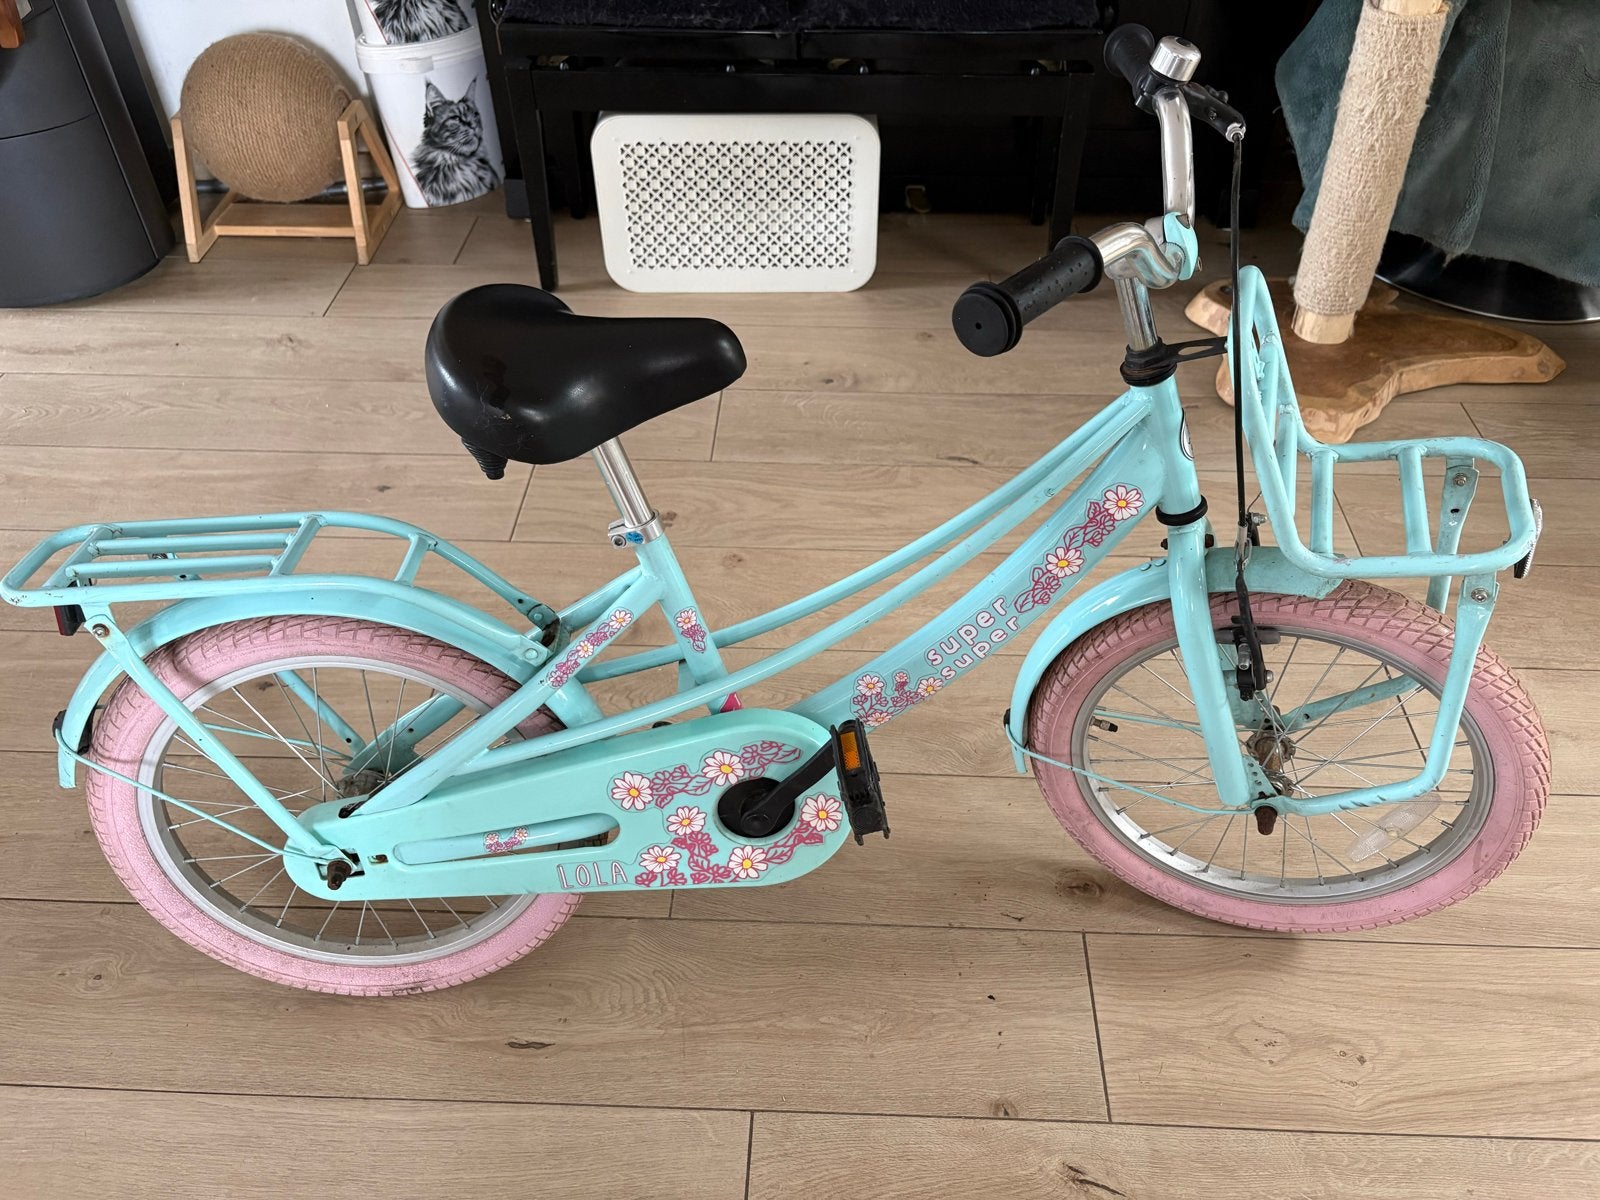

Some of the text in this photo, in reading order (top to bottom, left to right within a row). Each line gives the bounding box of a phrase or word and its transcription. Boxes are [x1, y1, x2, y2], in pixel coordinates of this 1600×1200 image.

[927, 597, 1008, 666] super
[940, 616, 1020, 680] super
[557, 861, 628, 889] LOLA
